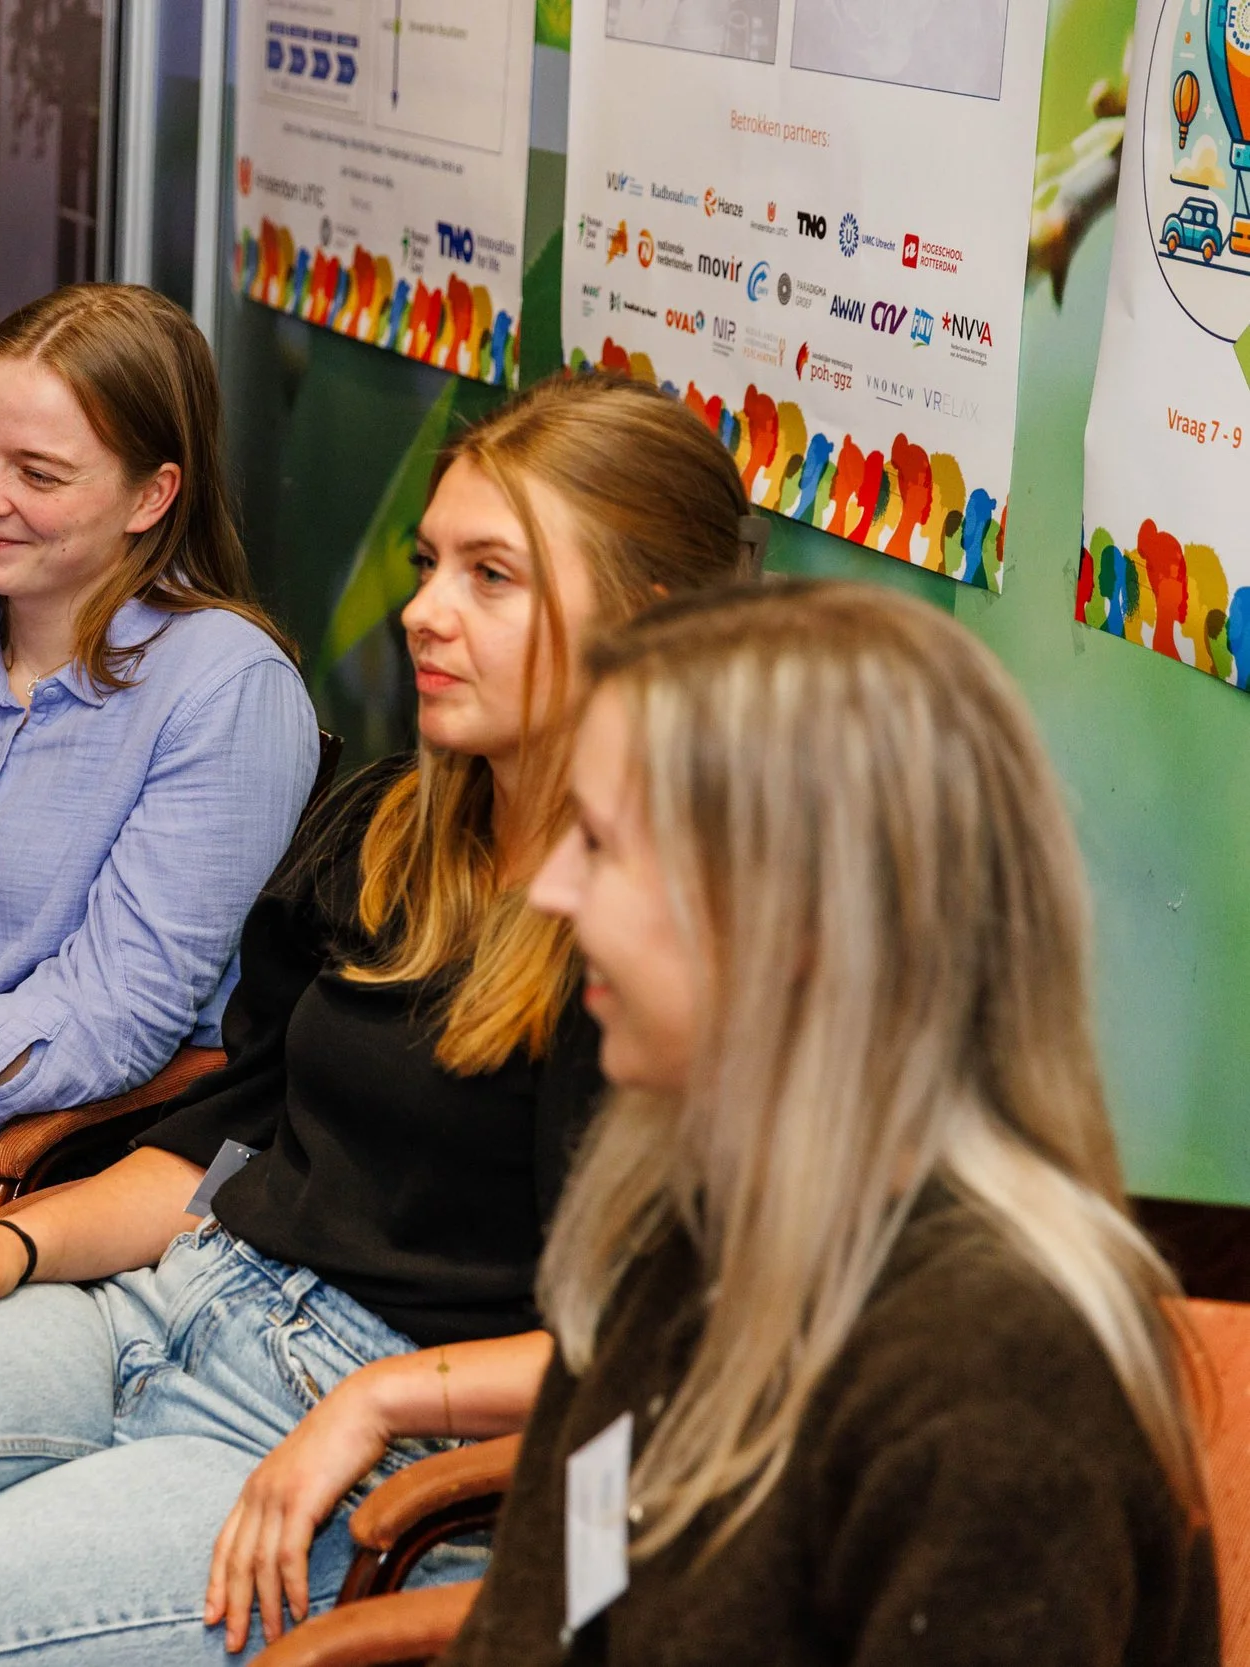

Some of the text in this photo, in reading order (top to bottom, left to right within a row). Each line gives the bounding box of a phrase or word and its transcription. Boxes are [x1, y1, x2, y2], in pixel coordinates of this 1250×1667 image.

[730, 109, 830, 147] Betrokken partners:
[718, 196, 743, 218] Hanze
[797, 211, 827, 240] TNO
[436, 219, 474, 264] TNO
[862, 234, 896, 251] UMC Utrecht
[921, 242, 963, 262] HOGESCHOOL
[698, 253, 743, 283] movir
[920, 256, 957, 274] ROTTERDAM
[797, 280, 827, 298] PARADIGMA
[665, 308, 696, 335] OVAL
[810, 364, 852, 391] poh-ggz
[923, 387, 981, 423] VRELAX
[1167, 407, 1207, 444] Vraag
[1211, 420, 1220, 442] 7
[1232, 427, 1243, 449] 9
